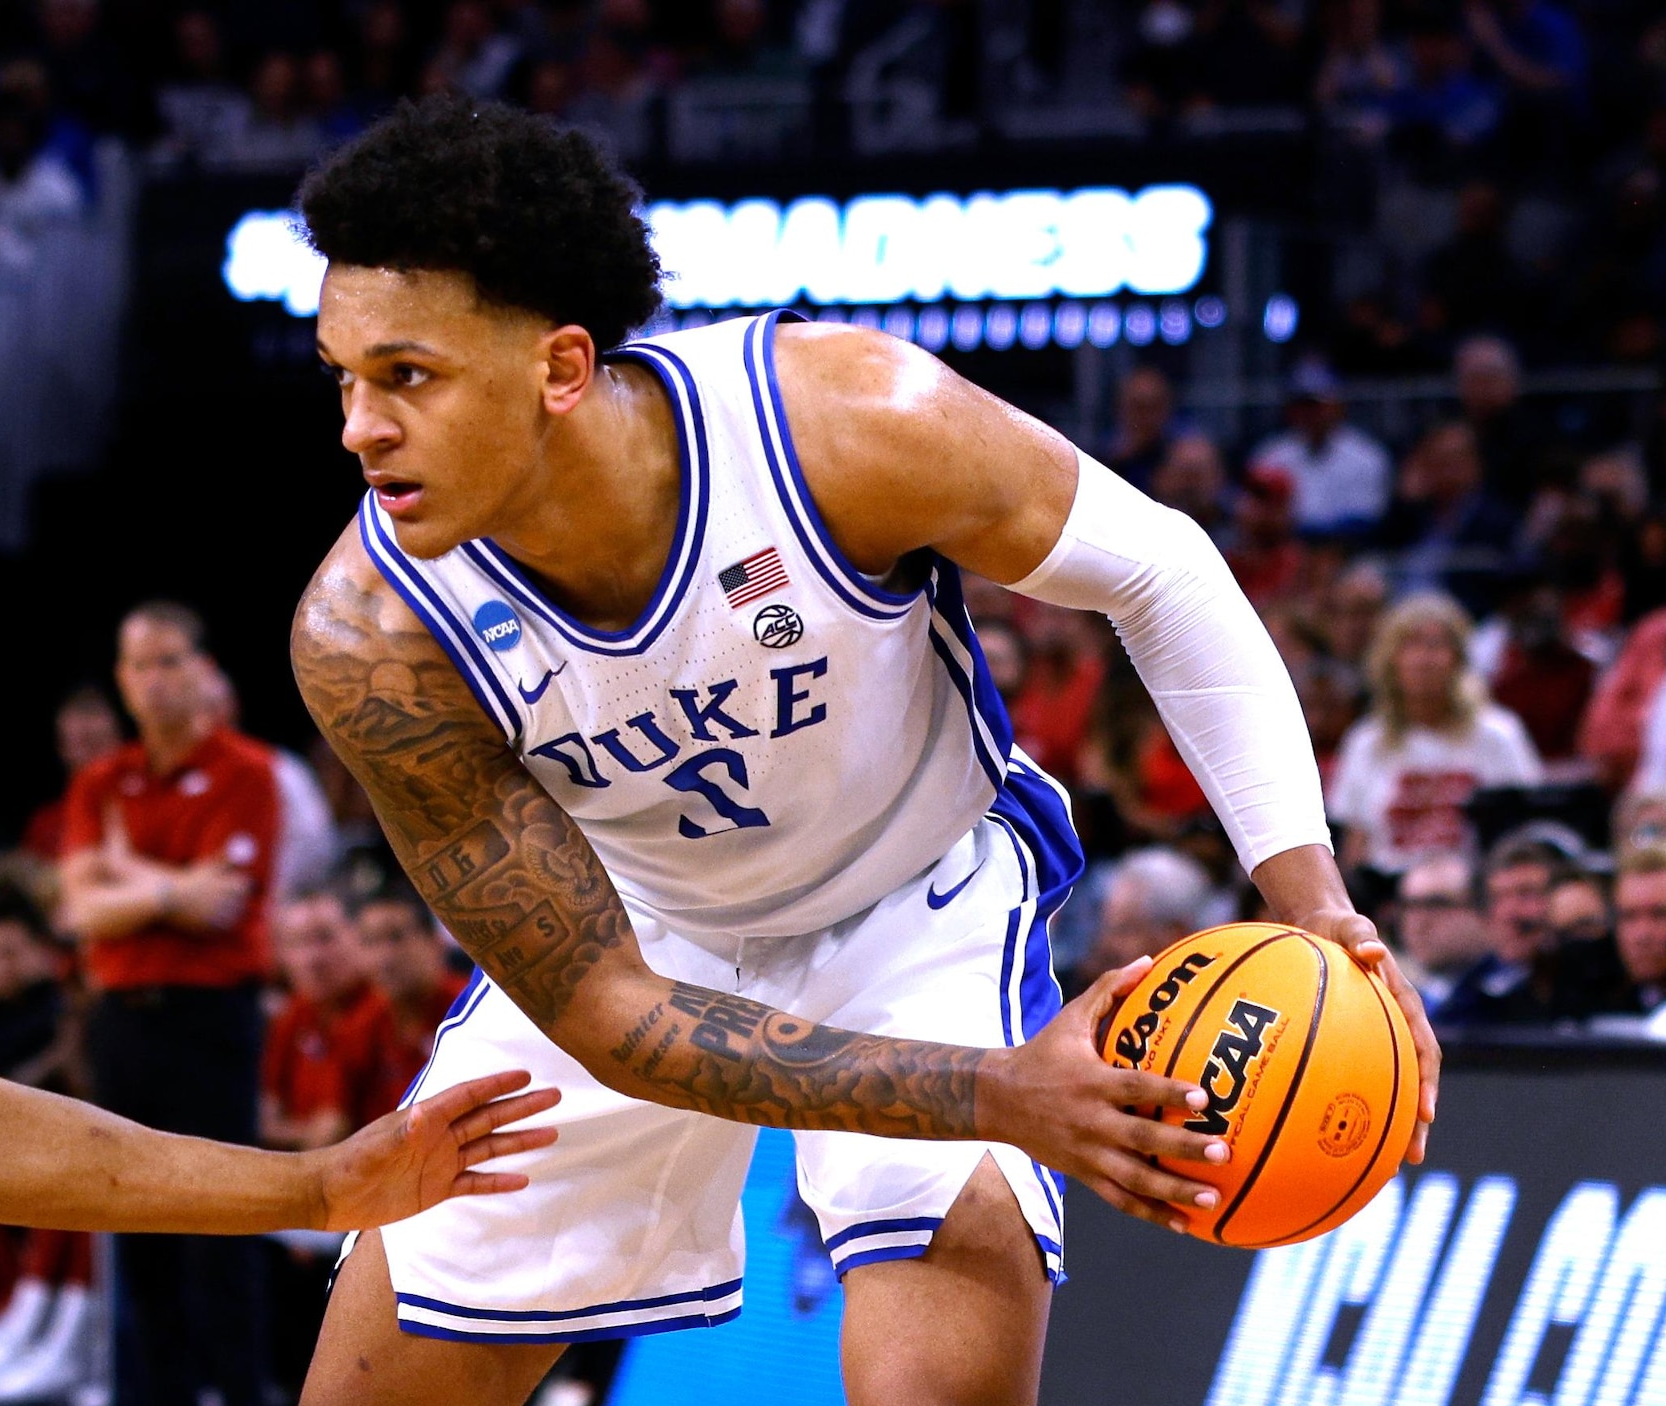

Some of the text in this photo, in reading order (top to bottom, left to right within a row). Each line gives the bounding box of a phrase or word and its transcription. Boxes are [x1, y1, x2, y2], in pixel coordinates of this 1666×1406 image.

[482, 618, 520, 643] NCAA
[760, 612, 798, 641] ACC
[528, 656, 828, 787] DUKE
[1112, 952, 1217, 1072] lson
[1155, 1016, 1173, 1047] NXT
[1183, 996, 1281, 1137] NCAA
[1247, 1055, 1270, 1099] GAME
[1267, 1017, 1290, 1054] BALL
